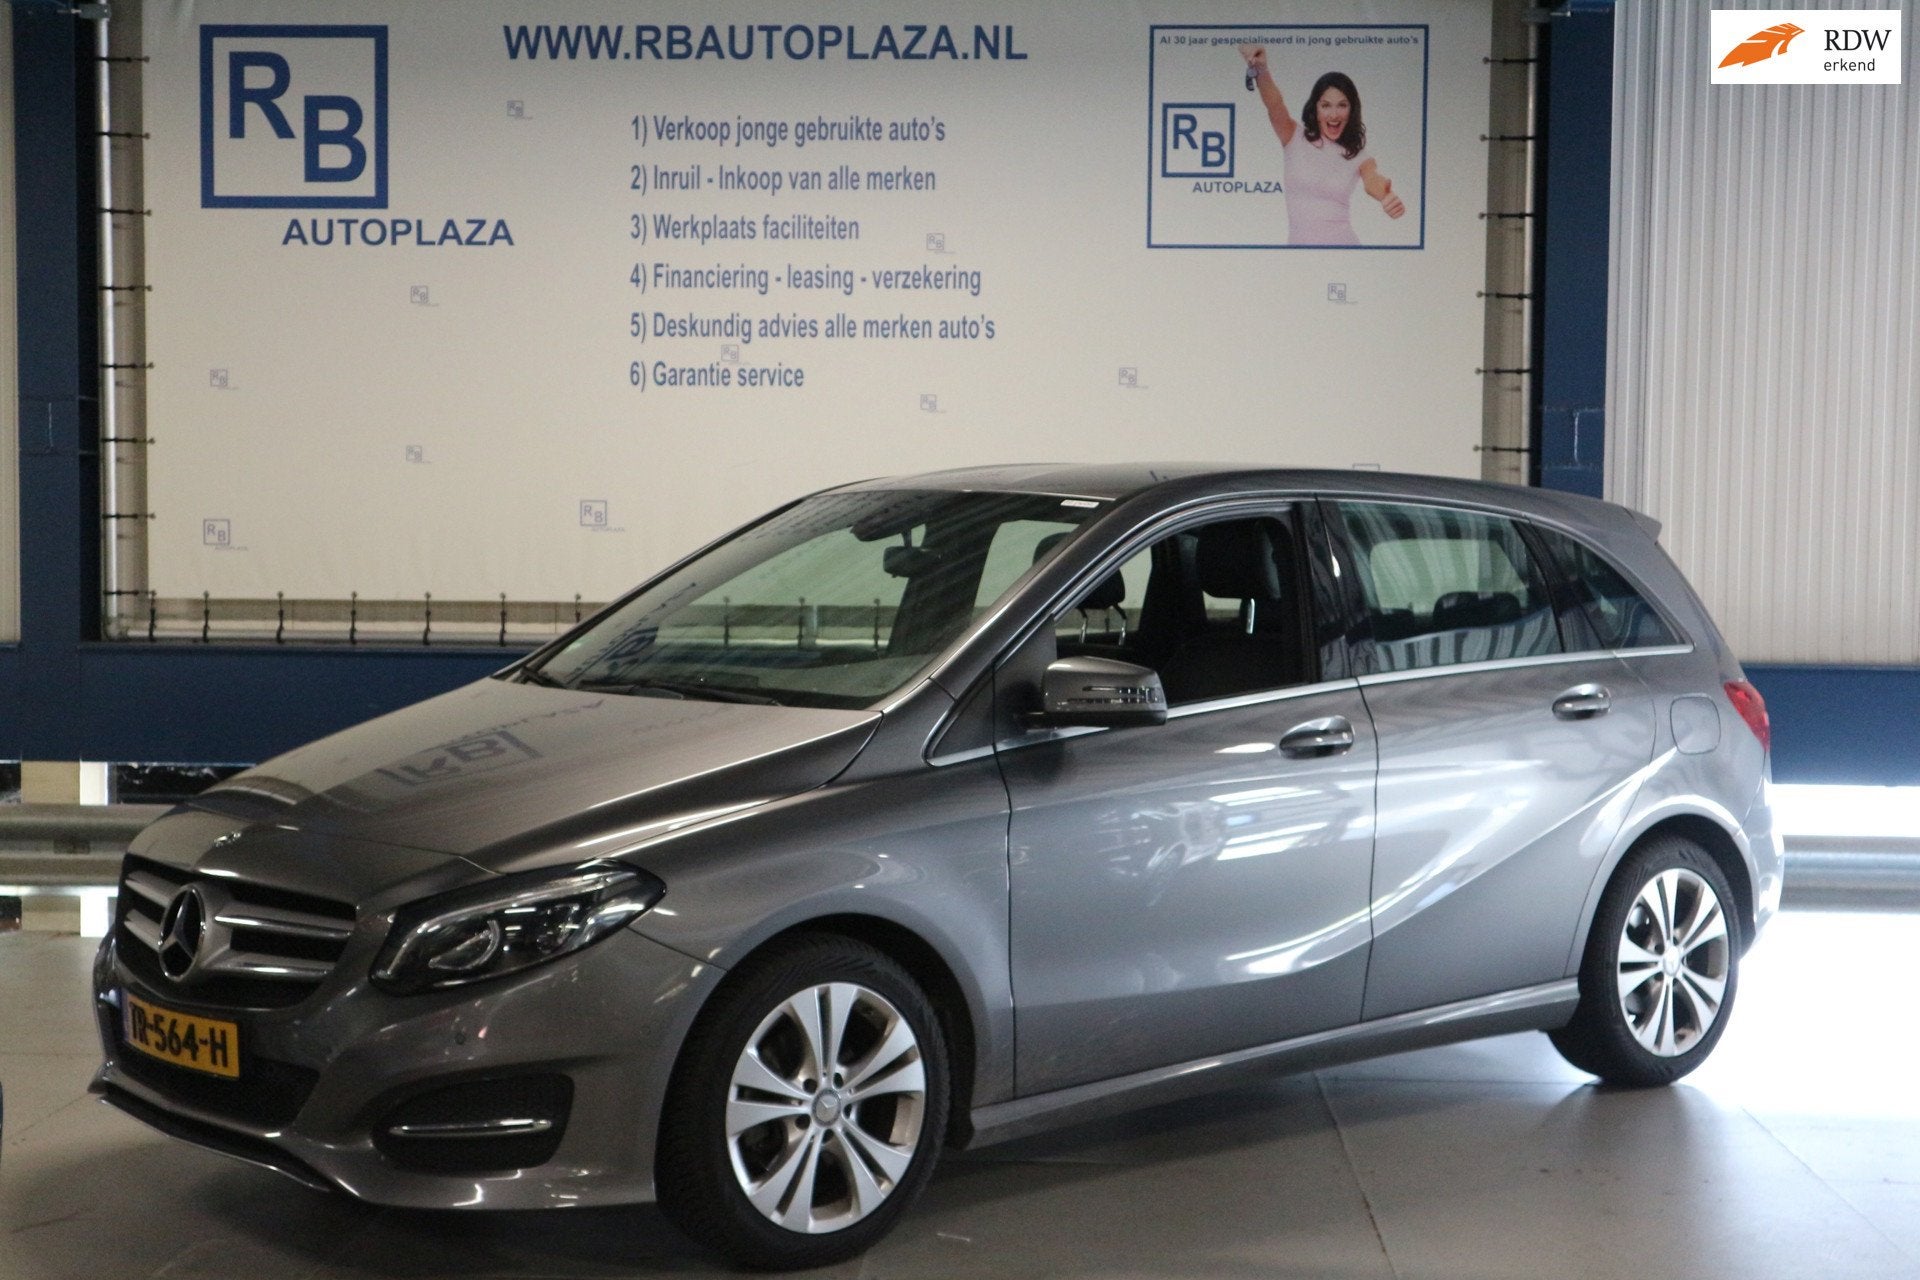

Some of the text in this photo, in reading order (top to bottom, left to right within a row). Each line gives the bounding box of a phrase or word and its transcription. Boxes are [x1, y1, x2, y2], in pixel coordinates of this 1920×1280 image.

[503, 24, 1028, 60] WWW.RBAUTOPLAZA.NL
[1174, 36, 1185, 44] 30
[1188, 36, 1208, 46] jaar
[1211, 36, 1293, 46] gespecialiseerd
[1295, 36, 1305, 44] in
[1308, 36, 1331, 46] jong
[1335, 36, 1384, 46] gebruikte
[1387, 36, 1419, 44] auto's
[229, 51, 367, 182] RB
[631, 115, 945, 147] 1) Verkoop jonge gebruikte auto’s
[1173, 114, 1227, 167] RB
[630, 165, 647, 196] 2)
[654, 165, 700, 189] Inruil
[719, 165, 782, 196] Inkoop
[788, 171, 821, 190] van
[828, 165, 860, 190] alle
[866, 165, 936, 190] merken
[1193, 181, 1283, 194] AUTOPLAZA
[282, 219, 514, 246] AUTOPLAZA
[630, 214, 860, 245] 3) Werkplaats faciliteiten
[630, 263, 647, 295] 4)
[653, 263, 769, 295] Financiering
[787, 263, 854, 295] leasing
[872, 264, 981, 296] verzekering
[630, 312, 995, 344] 5) Deskundig advies alle merken auto’s
[630, 361, 804, 392] 6) Garantie service
